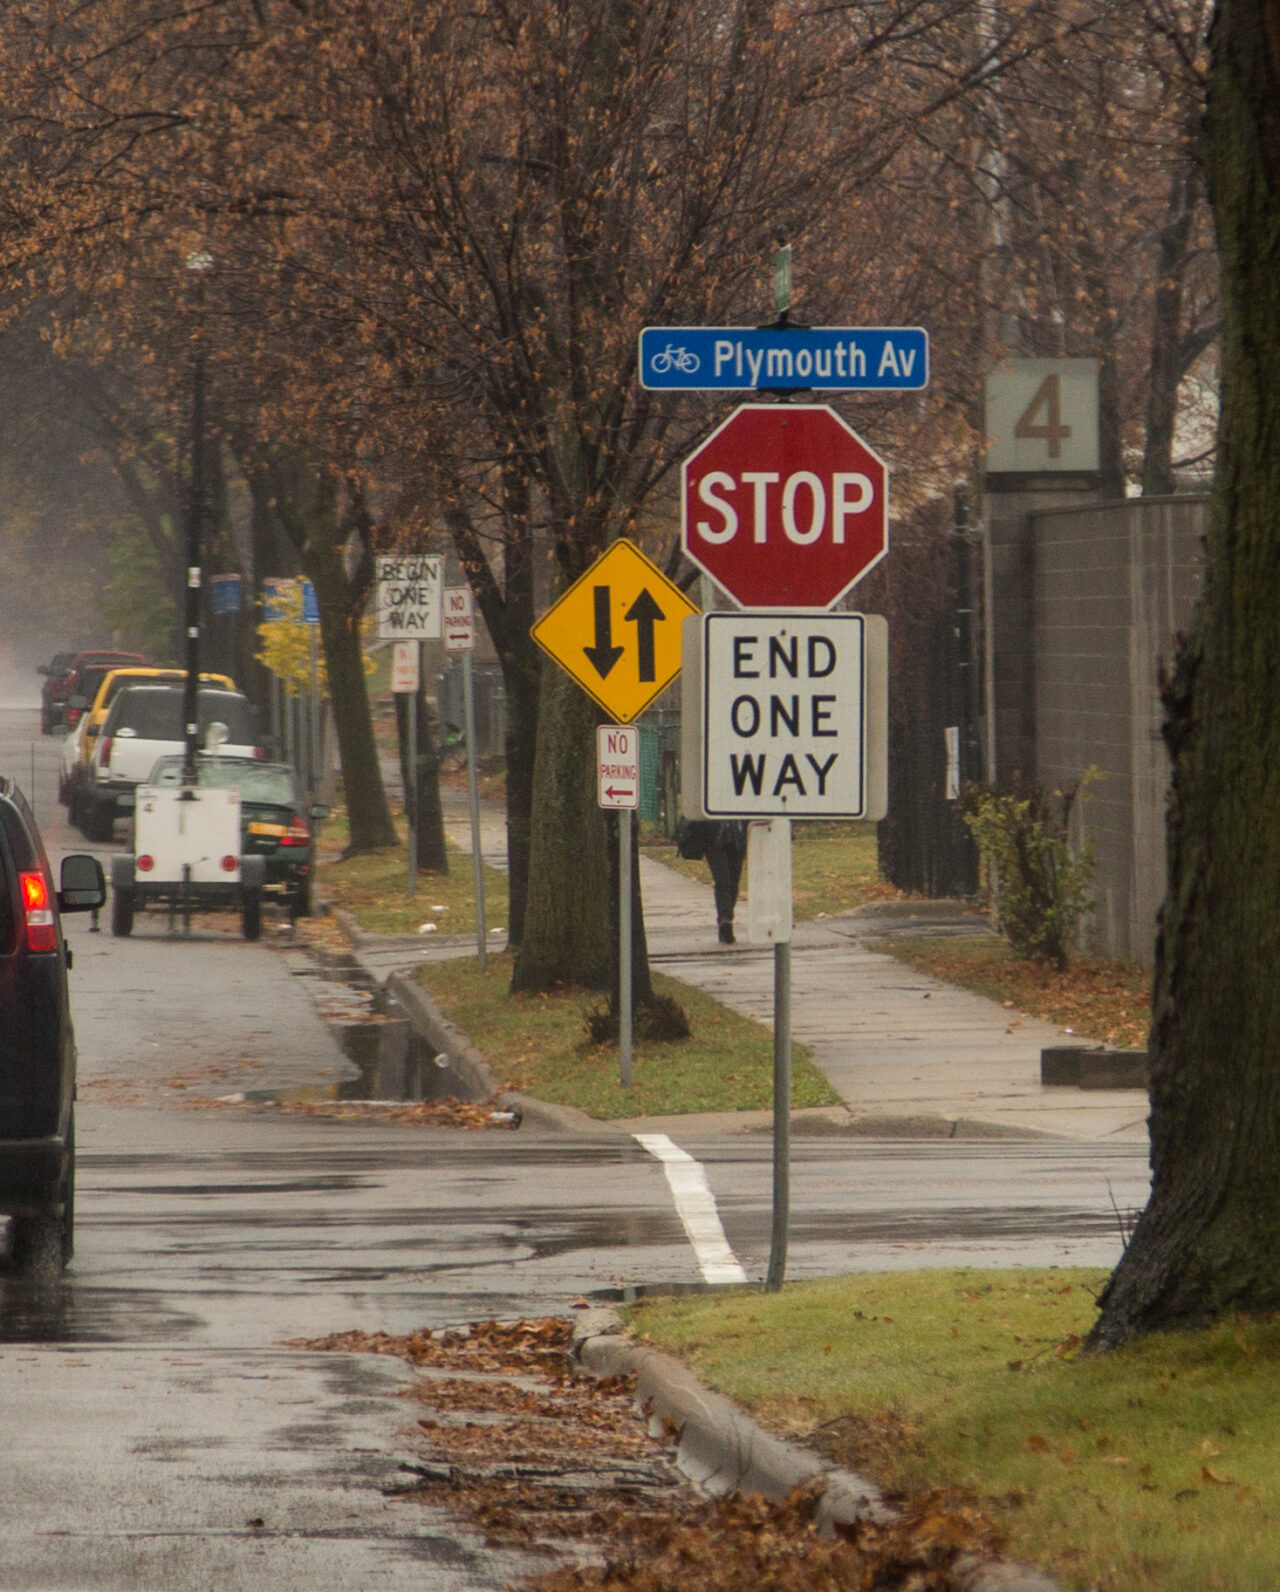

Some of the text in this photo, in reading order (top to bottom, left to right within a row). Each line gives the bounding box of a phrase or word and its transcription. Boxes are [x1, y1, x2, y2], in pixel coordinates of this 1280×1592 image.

[714, 340, 917, 387] Plymouth Av
[1015, 373, 1072, 458] 4
[696, 471, 874, 545] STOP
[381, 563, 437, 581] BEGIN
[391, 587, 429, 606] ONE
[450, 596, 465, 611] NO
[390, 611, 429, 629] WAY
[733, 636, 837, 679] END
[731, 695, 838, 738] ONE
[608, 734, 628, 755] NO
[601, 764, 636, 780] PARKING
[730, 754, 839, 796] WAY
